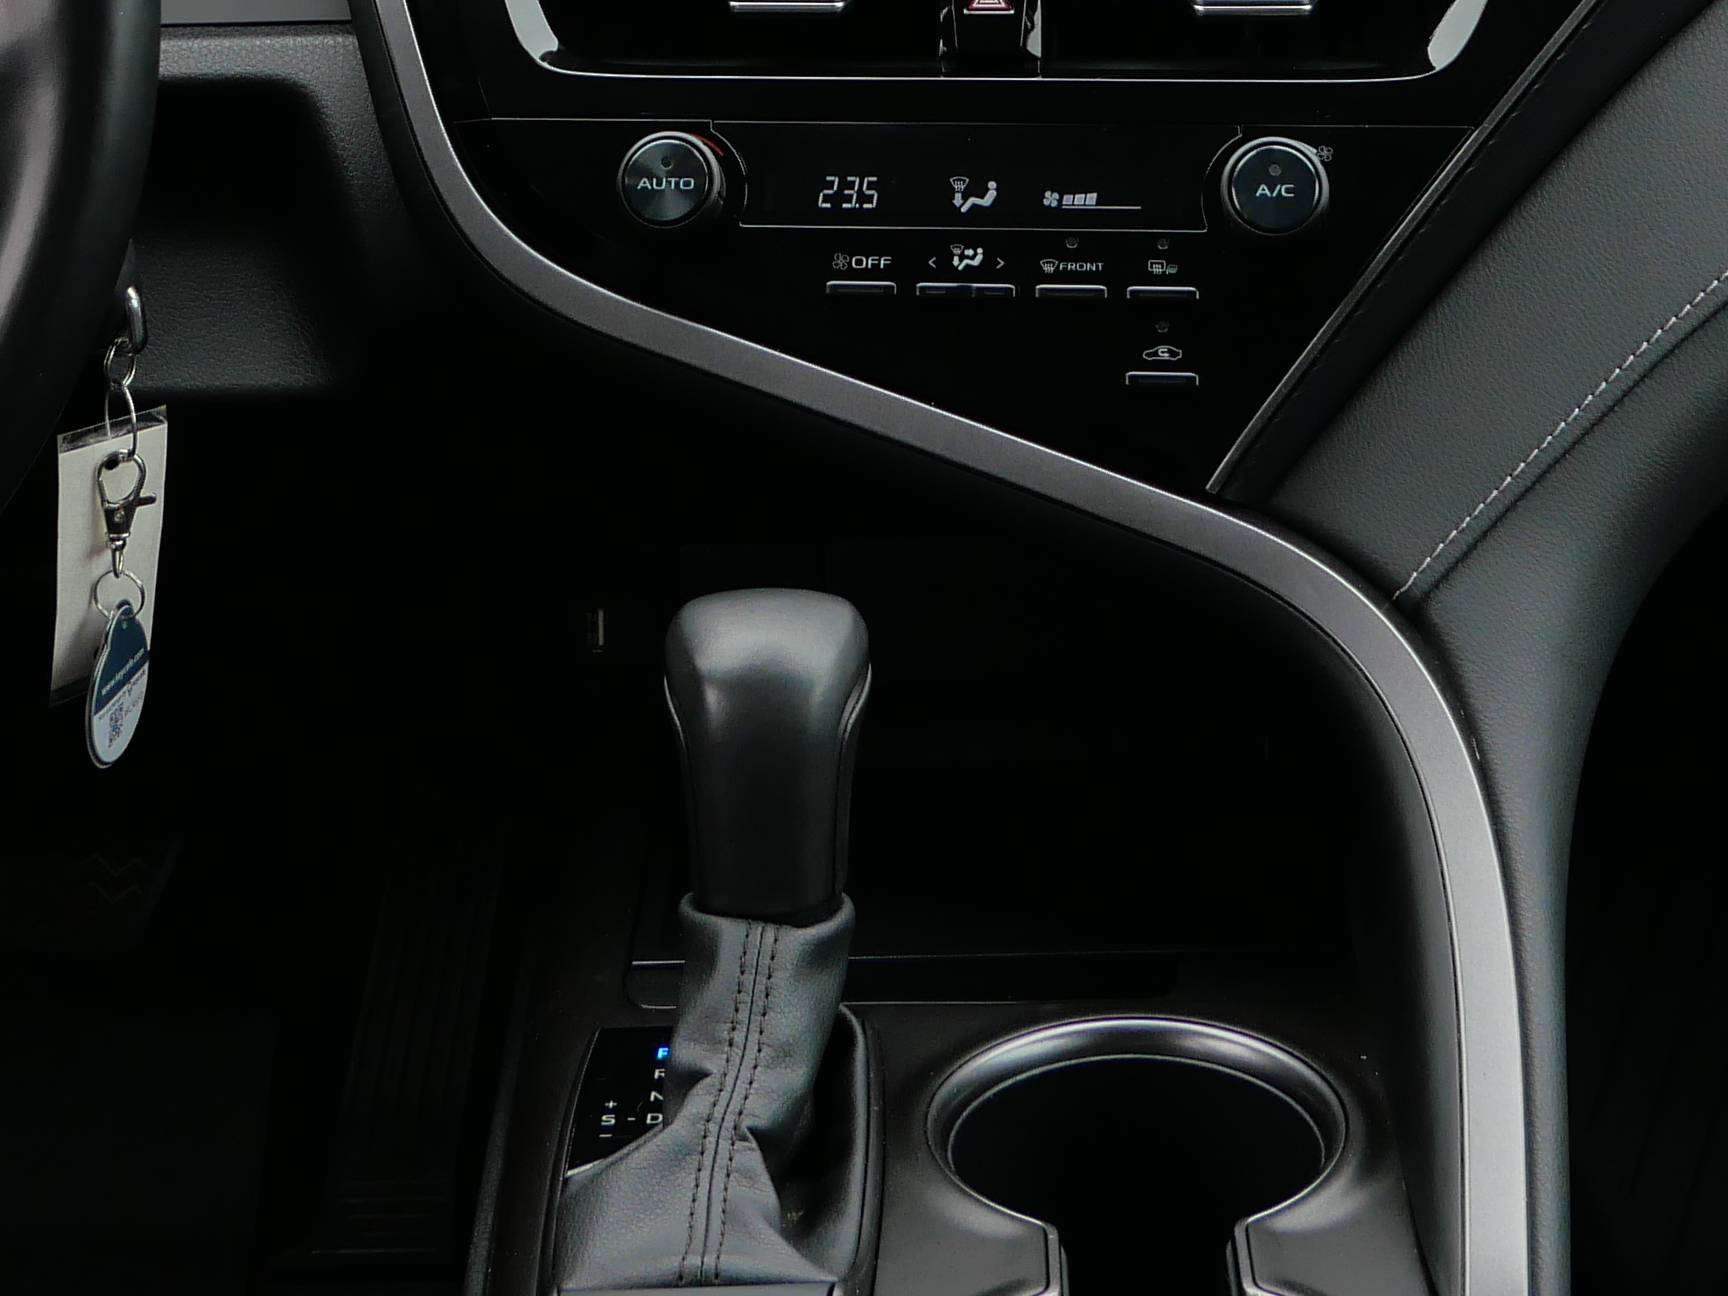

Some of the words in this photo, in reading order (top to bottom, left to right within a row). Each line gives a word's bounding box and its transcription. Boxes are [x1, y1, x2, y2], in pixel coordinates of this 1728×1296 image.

[636, 176, 696, 190] AUTO
[1255, 183, 1296, 198] A/C
[851, 256, 893, 270] OFF
[1059, 261, 1105, 272] FRONT
[600, 1114, 616, 1127] S
[645, 1112, 663, 1125] D
